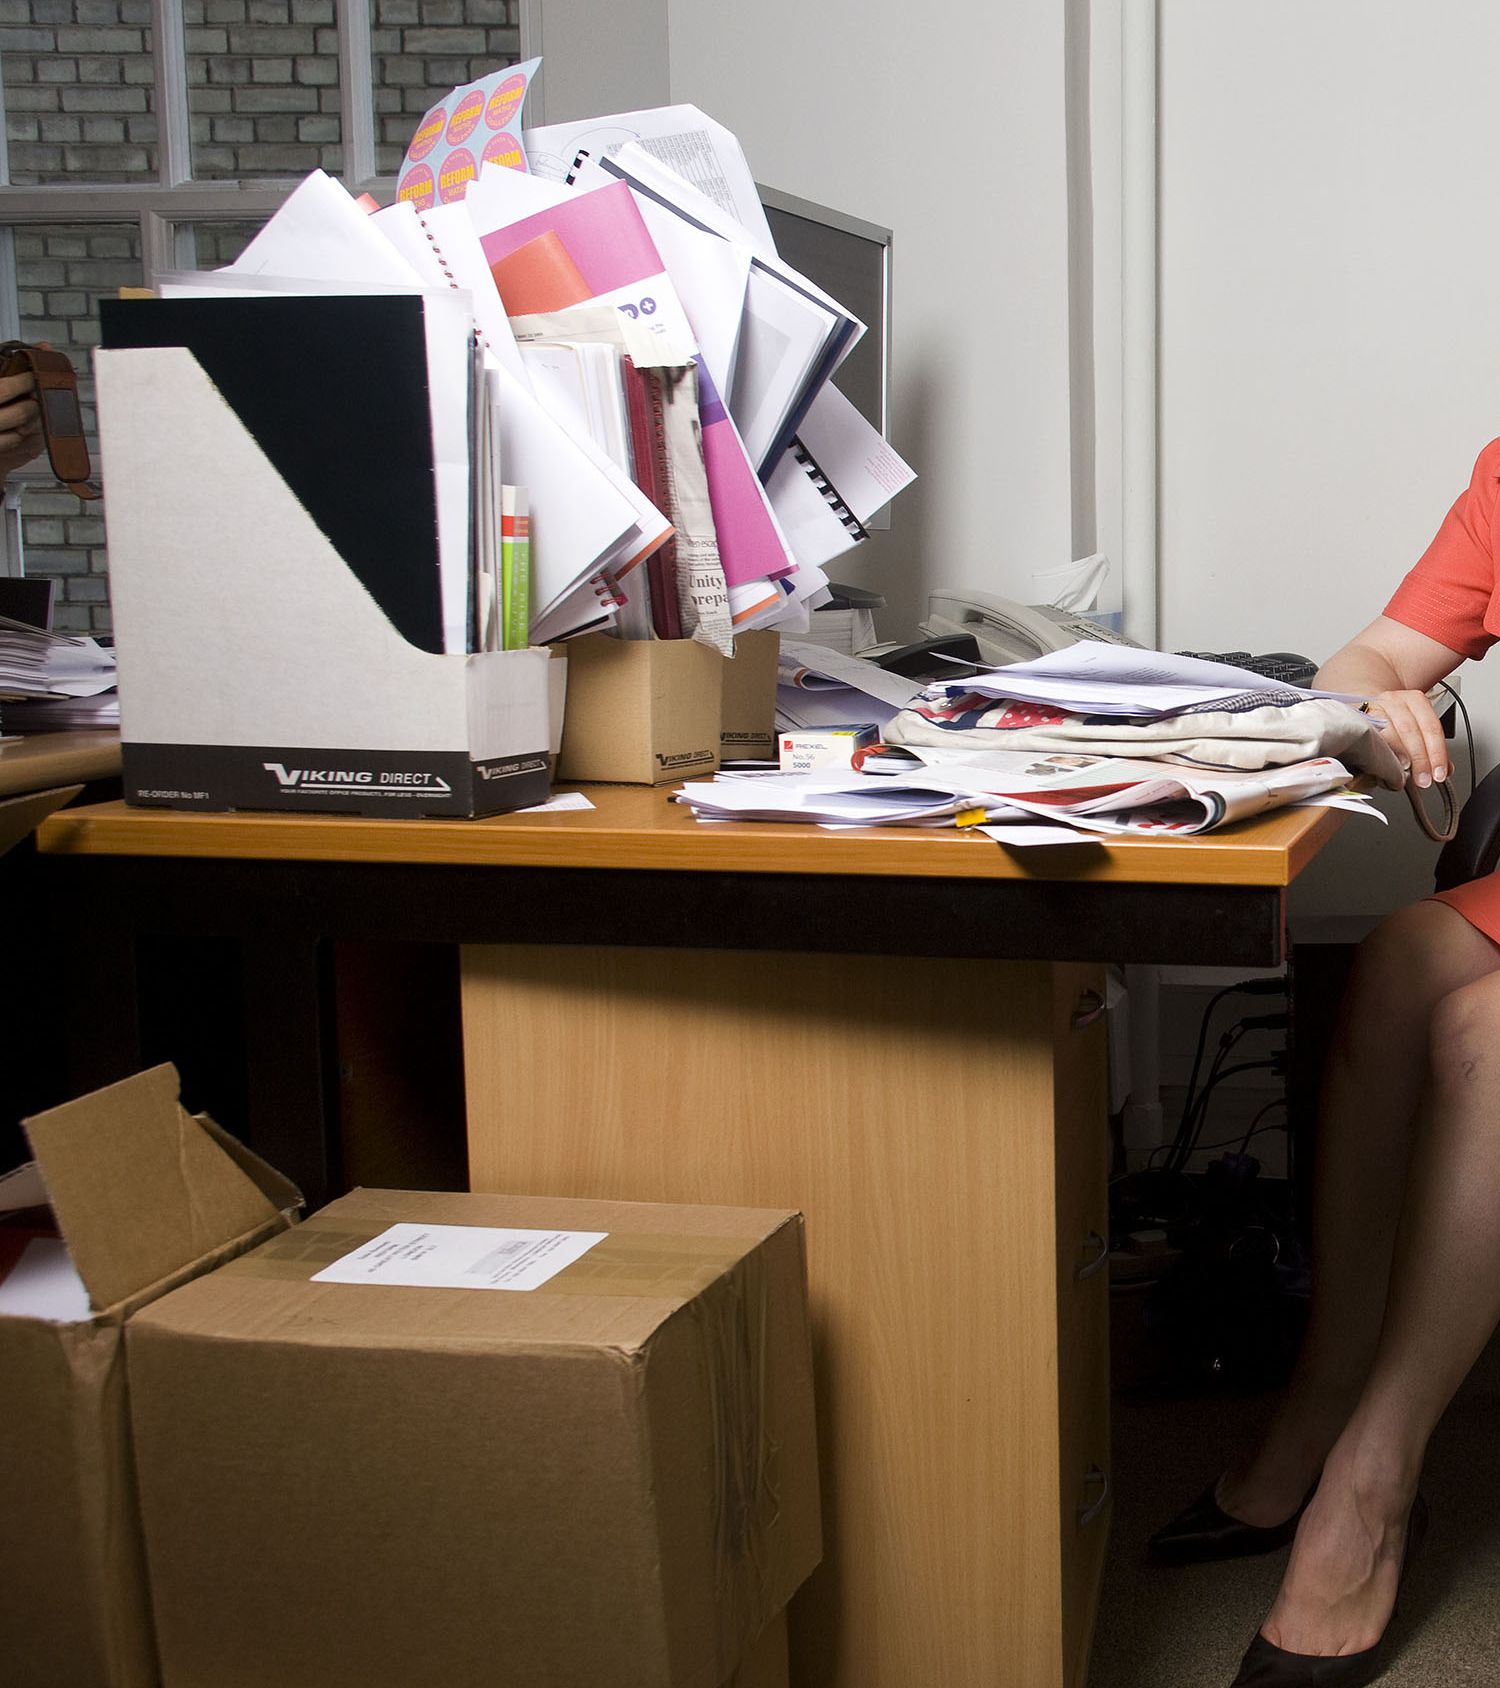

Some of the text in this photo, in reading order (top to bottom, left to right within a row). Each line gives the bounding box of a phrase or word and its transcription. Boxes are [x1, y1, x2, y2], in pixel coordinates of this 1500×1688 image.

[488, 86, 524, 109] REFORM
[452, 103, 483, 125] REFORM
[440, 164, 475, 189] REFORM
[399, 179, 433, 201] REFORM
[689, 575, 723, 590] Unity
[655, 752, 693, 767] VIKING
[792, 761, 811, 769] 5000
[263, 762, 433, 786] VIKING DIRECT
[476, 762, 520, 780] VIKING
